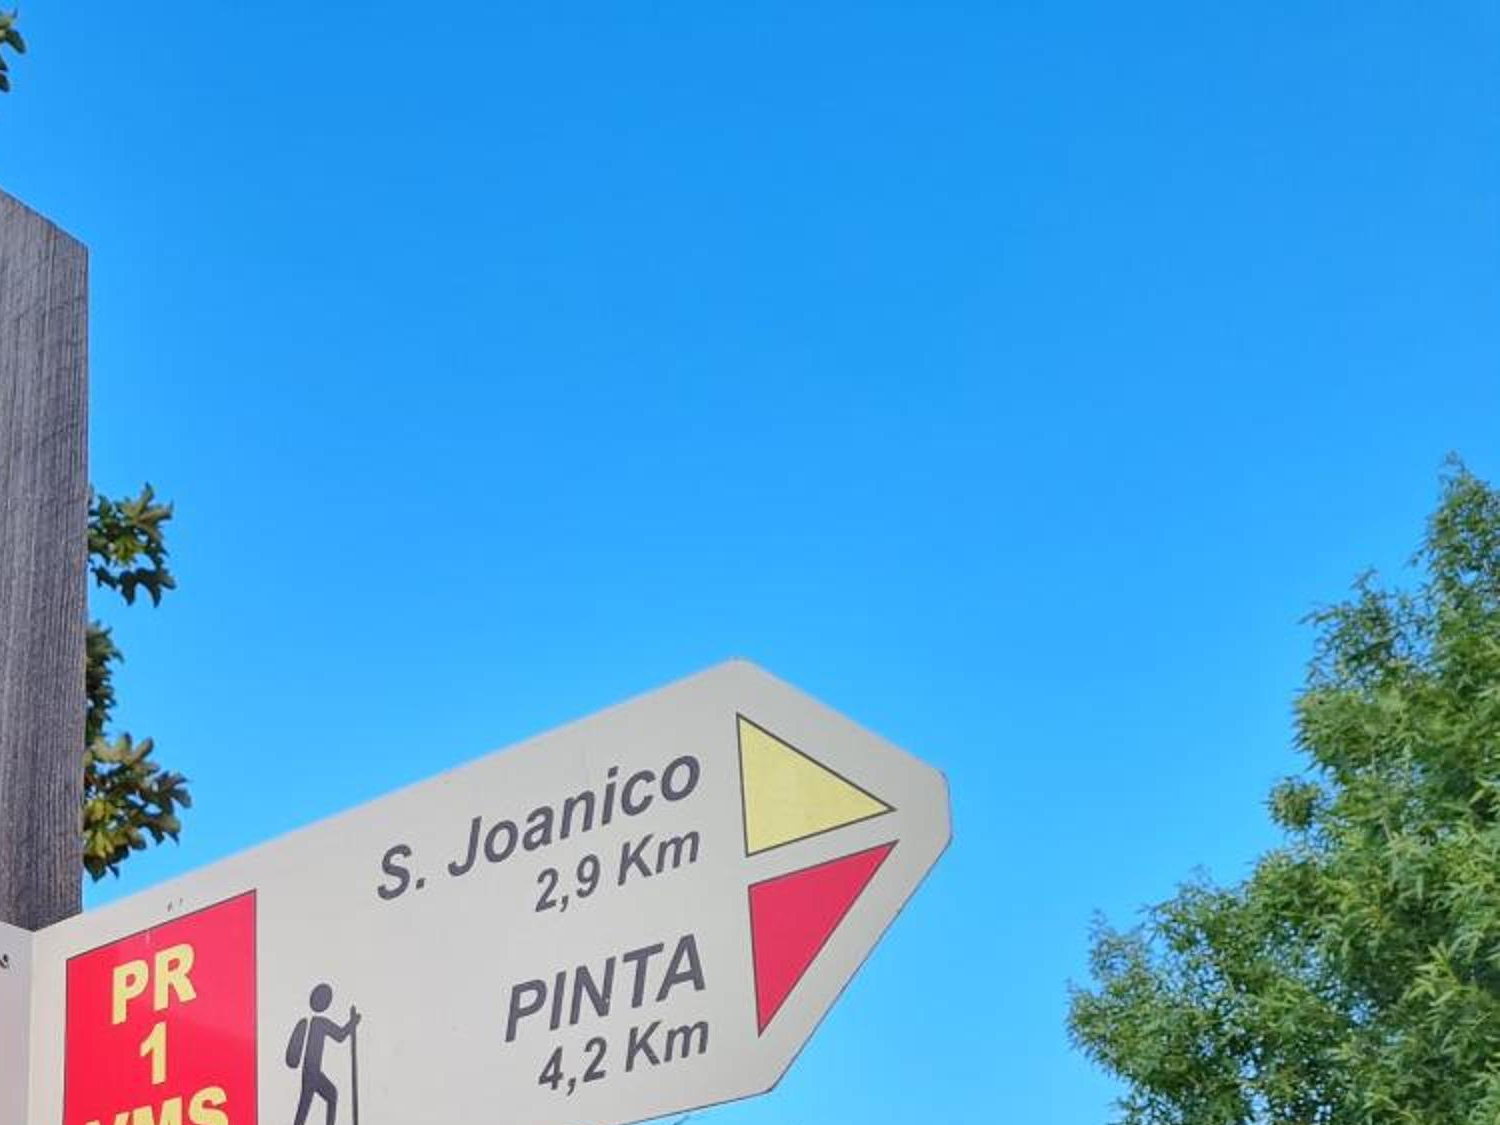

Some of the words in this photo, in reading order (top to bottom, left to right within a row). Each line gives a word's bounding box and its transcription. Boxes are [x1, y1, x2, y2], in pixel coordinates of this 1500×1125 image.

[377, 844, 426, 901] S.
[447, 755, 701, 877] Joanico
[535, 853, 601, 913] 2,9
[617, 831, 700, 887] Km
[112, 943, 197, 1025] PR
[504, 933, 706, 1043] PINTA
[139, 1021, 167, 1085] 1
[538, 1036, 607, 1097] 4,2
[625, 1020, 709, 1073] Km
